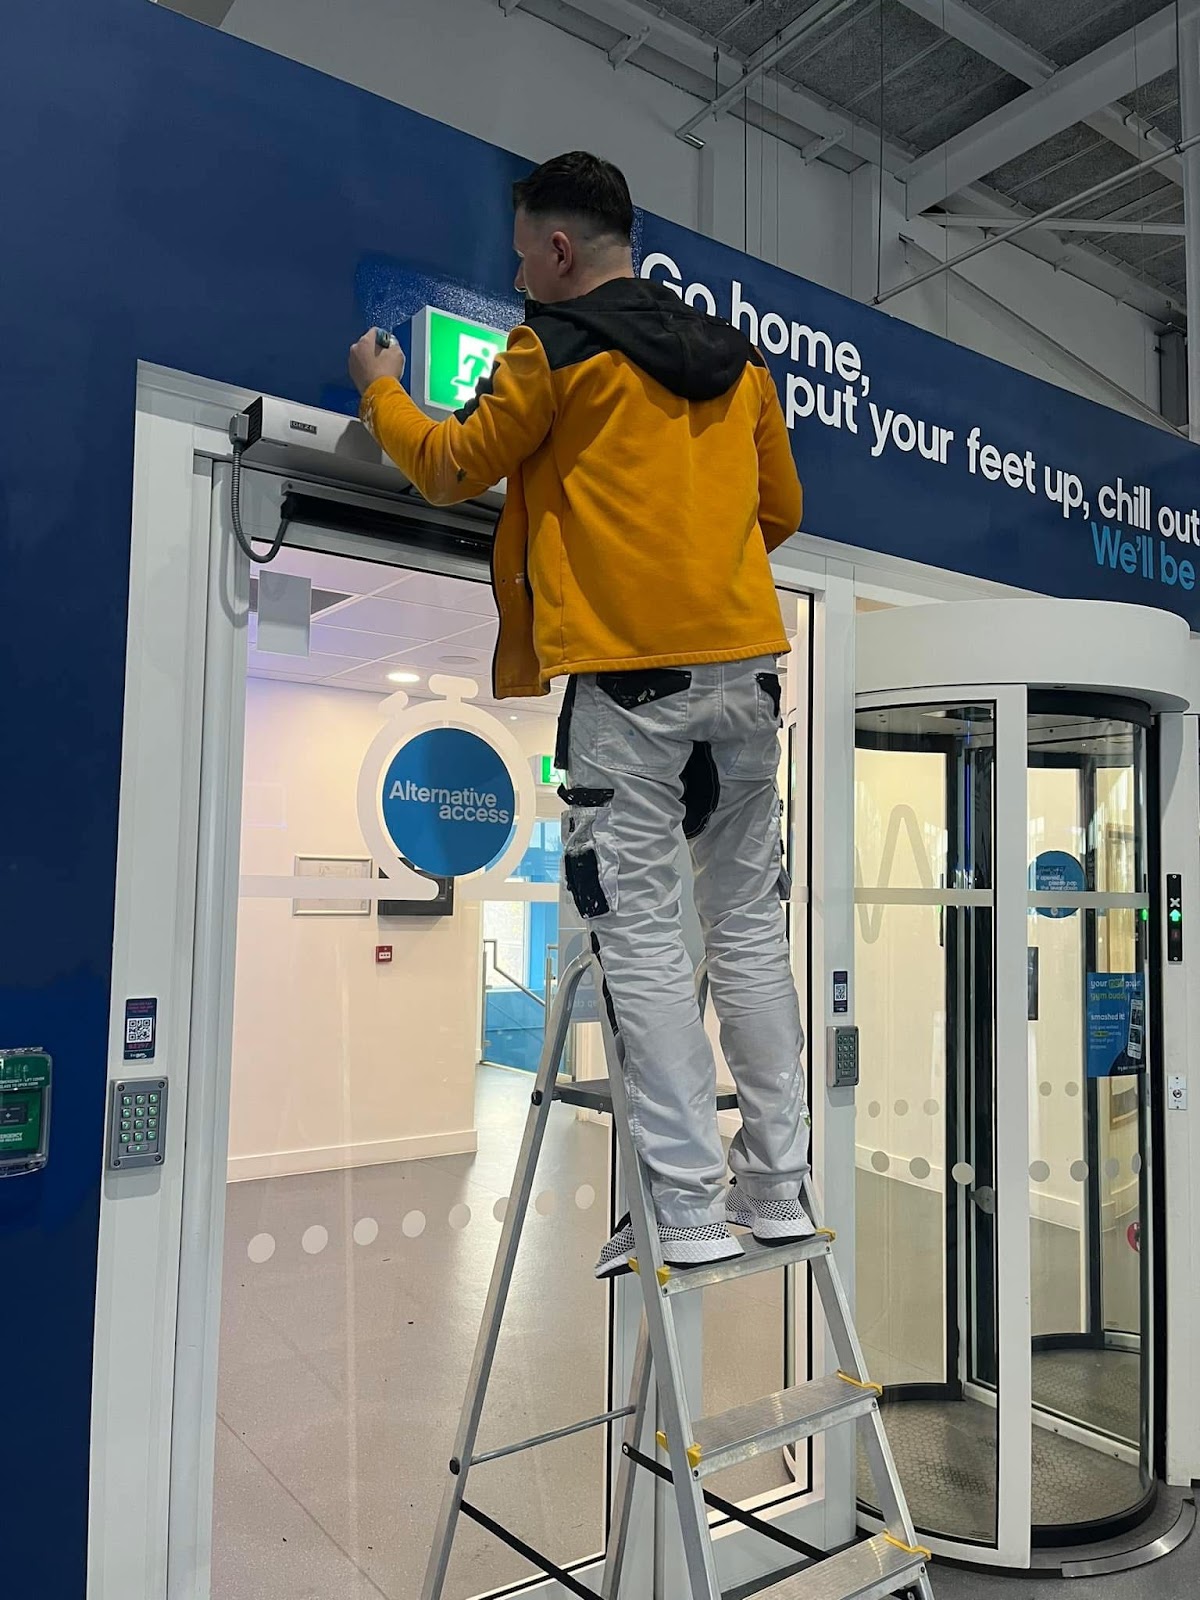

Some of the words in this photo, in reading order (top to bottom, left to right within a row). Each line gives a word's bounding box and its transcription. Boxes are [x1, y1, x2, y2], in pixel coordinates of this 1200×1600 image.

[641, 253, 717, 317] Go
[732, 281, 870, 398] home,
[786, 373, 858, 434] put
[869, 403, 954, 465] your
[967, 428, 1036, 494] feet
[1045, 466, 1091, 520] up,
[1099, 478, 1151, 531] chill
[1158, 507, 1200, 547] out
[1091, 522, 1154, 579] We'll
[1161, 543, 1196, 590] be
[389, 780, 498, 808] Alternative
[439, 805, 510, 824] access
[1090, 980, 1108, 989] your
[1090, 1013, 1118, 1021] smashed
